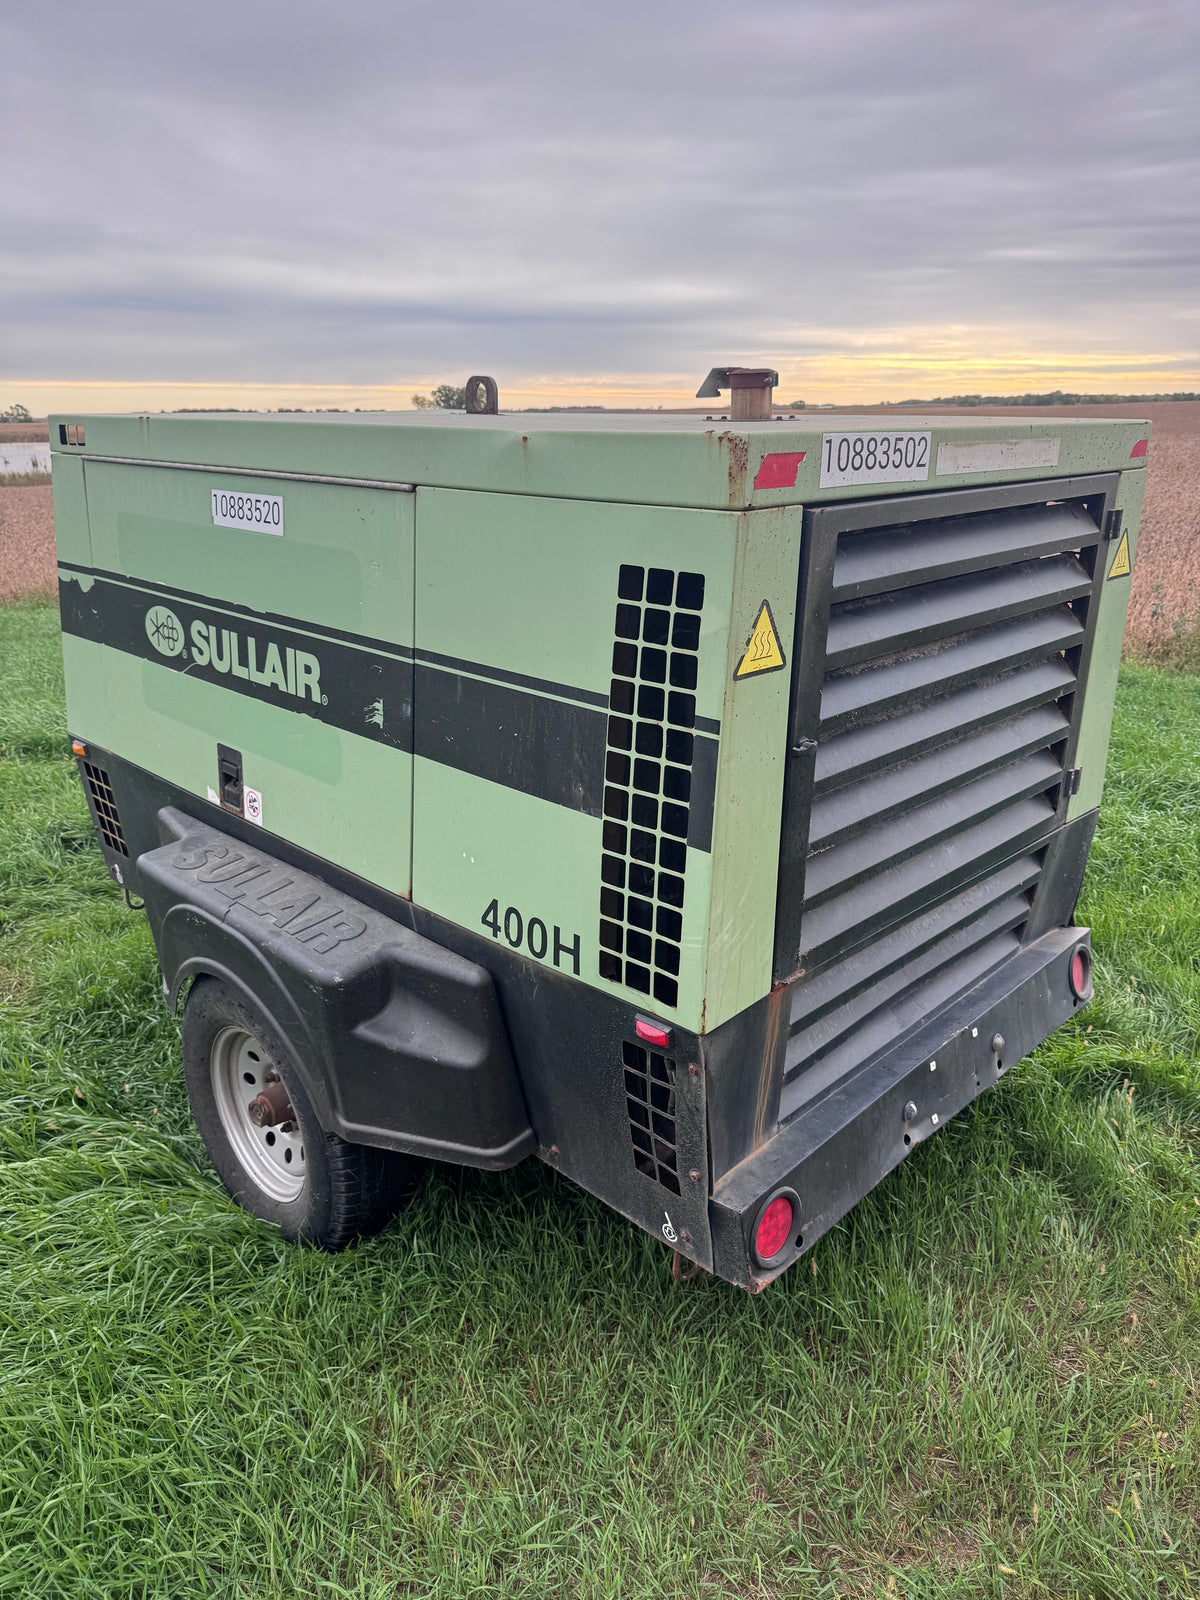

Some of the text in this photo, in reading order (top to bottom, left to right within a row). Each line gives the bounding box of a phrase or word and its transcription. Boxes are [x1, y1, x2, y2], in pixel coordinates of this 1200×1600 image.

[825, 436, 928, 473] 10883502
[213, 494, 280, 525] 10883520
[190, 619, 321, 704] SULLAIR
[171, 846, 368, 955] SULLAIR
[481, 898, 581, 976] 400H
